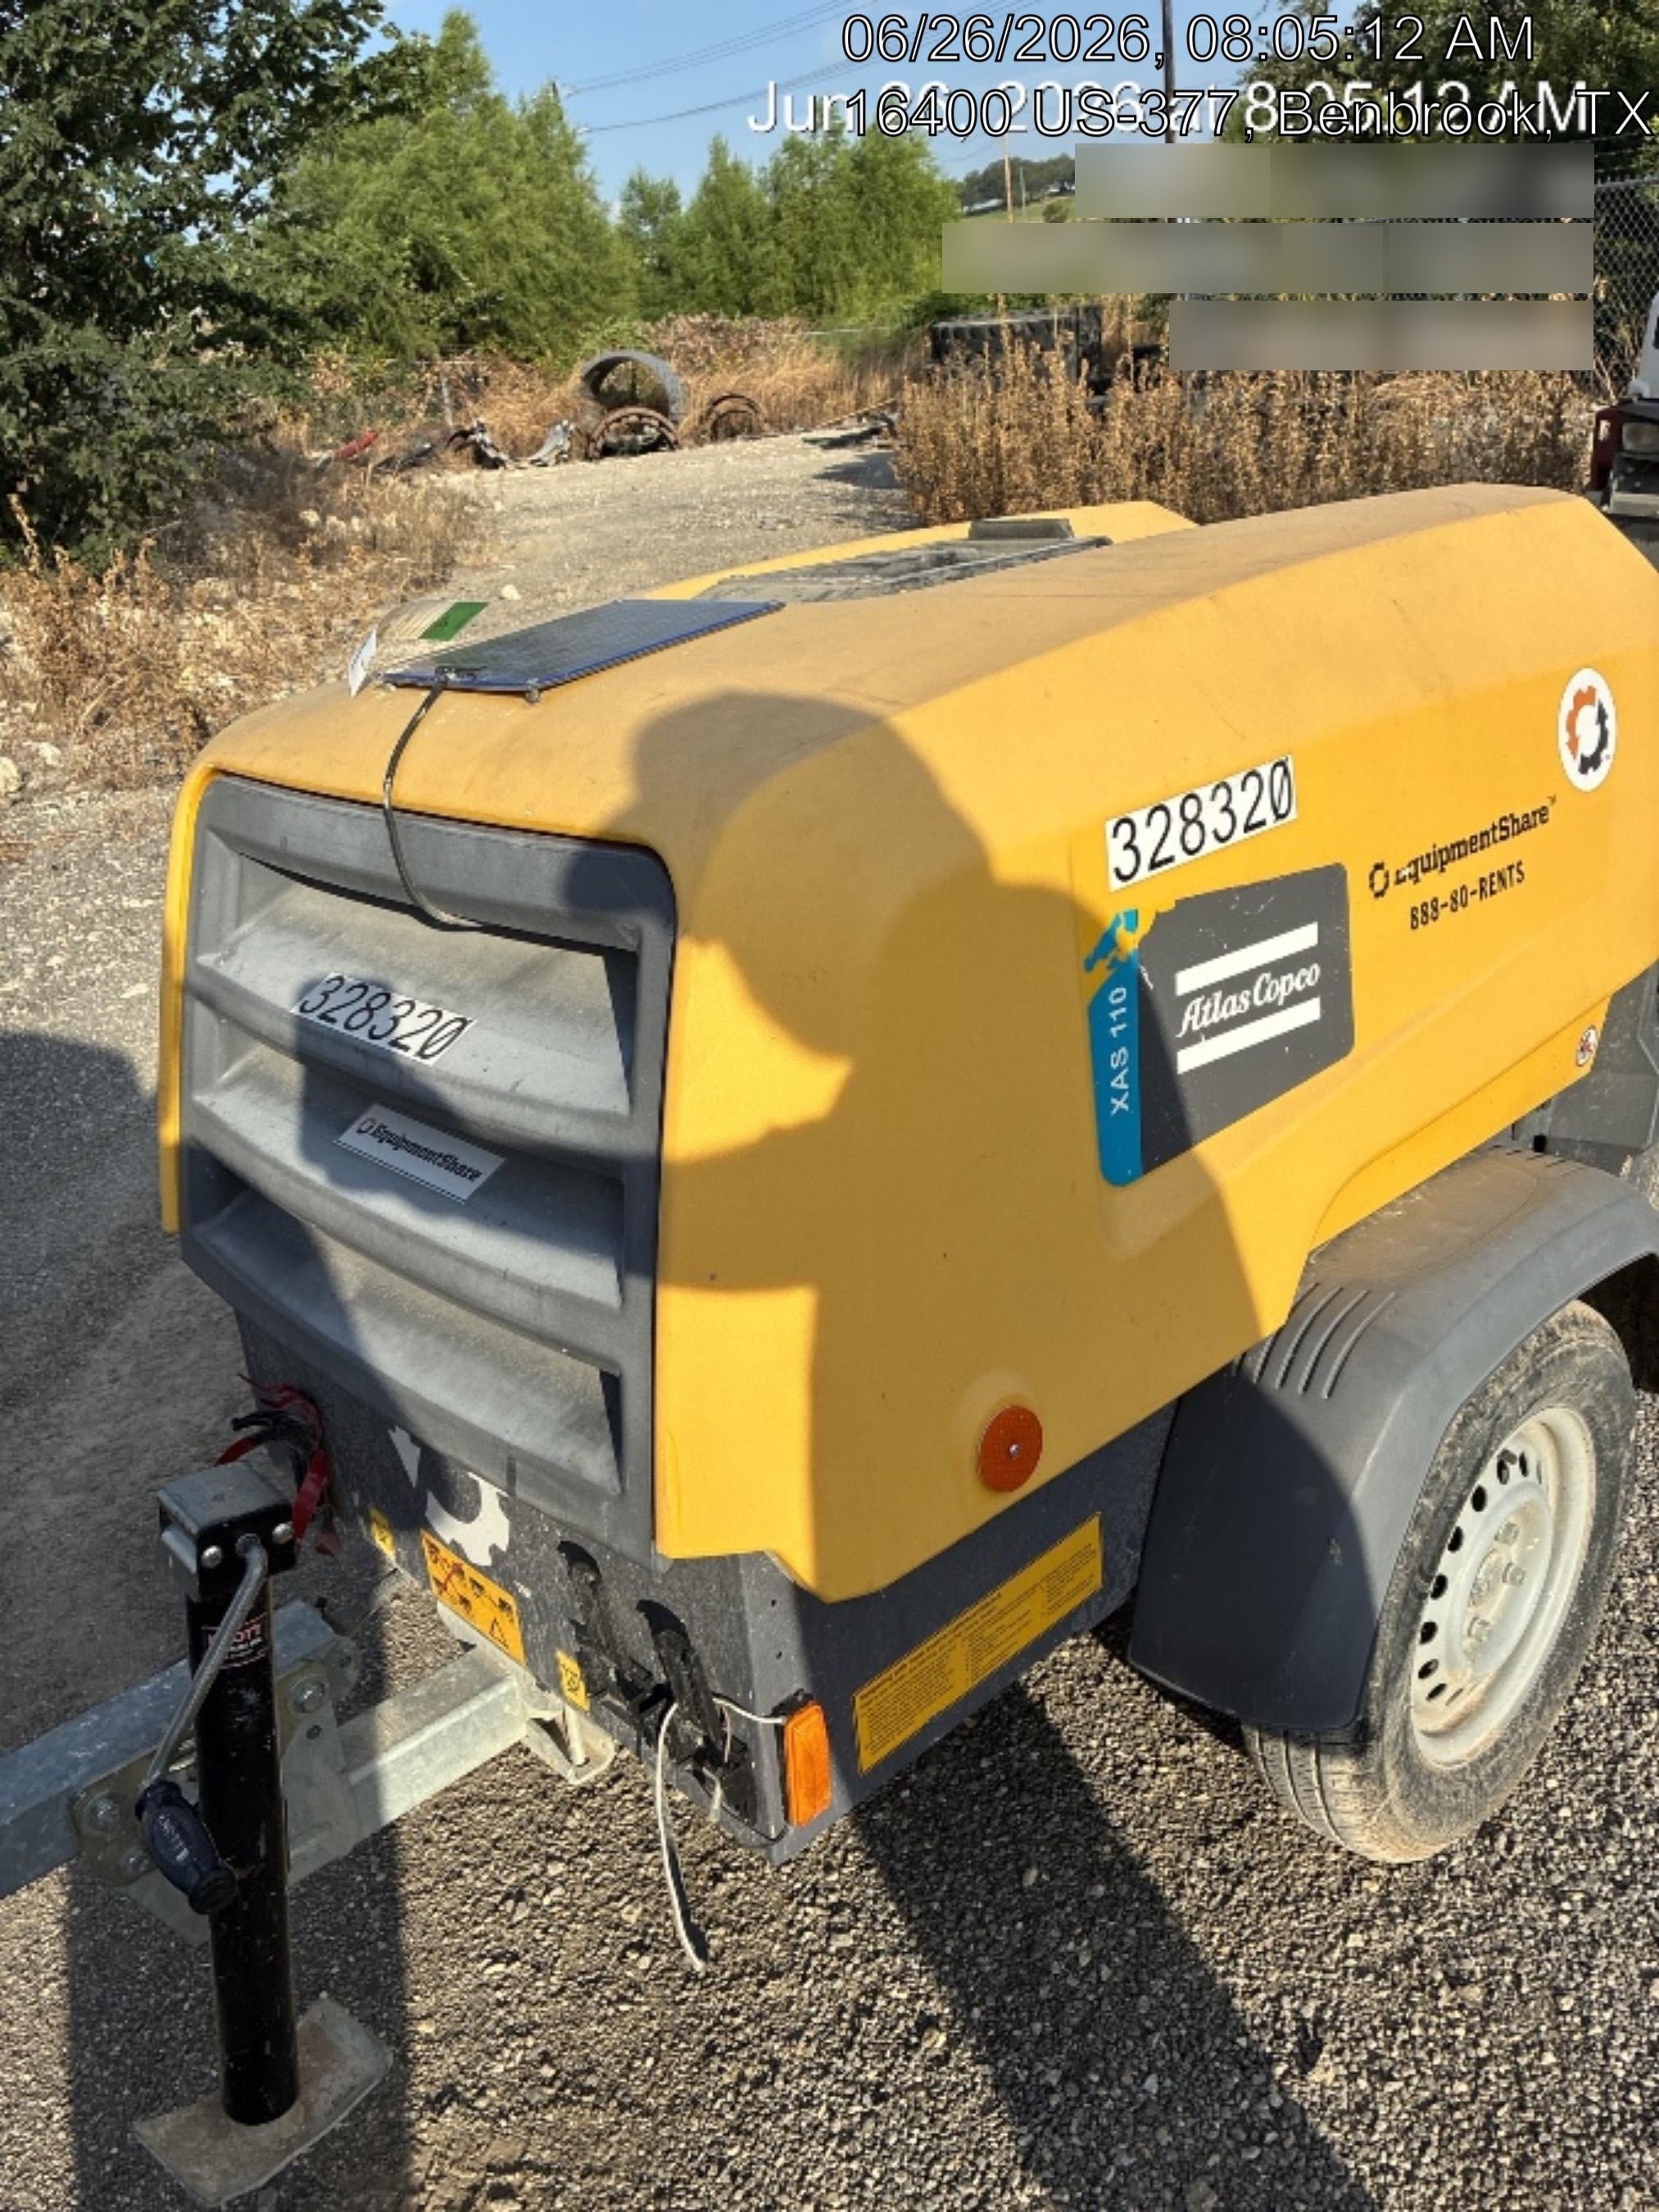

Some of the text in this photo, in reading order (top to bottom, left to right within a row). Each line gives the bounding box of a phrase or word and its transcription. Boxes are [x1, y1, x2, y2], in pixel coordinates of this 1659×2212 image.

[1112, 756, 1293, 882] 328320
[1410, 860, 1525, 931] 888-80-RENTS
[298, 975, 474, 1060] 328320
[1176, 963, 1321, 1038] Atlas Copco
[1108, 986, 1130, 1116] XAS 110
